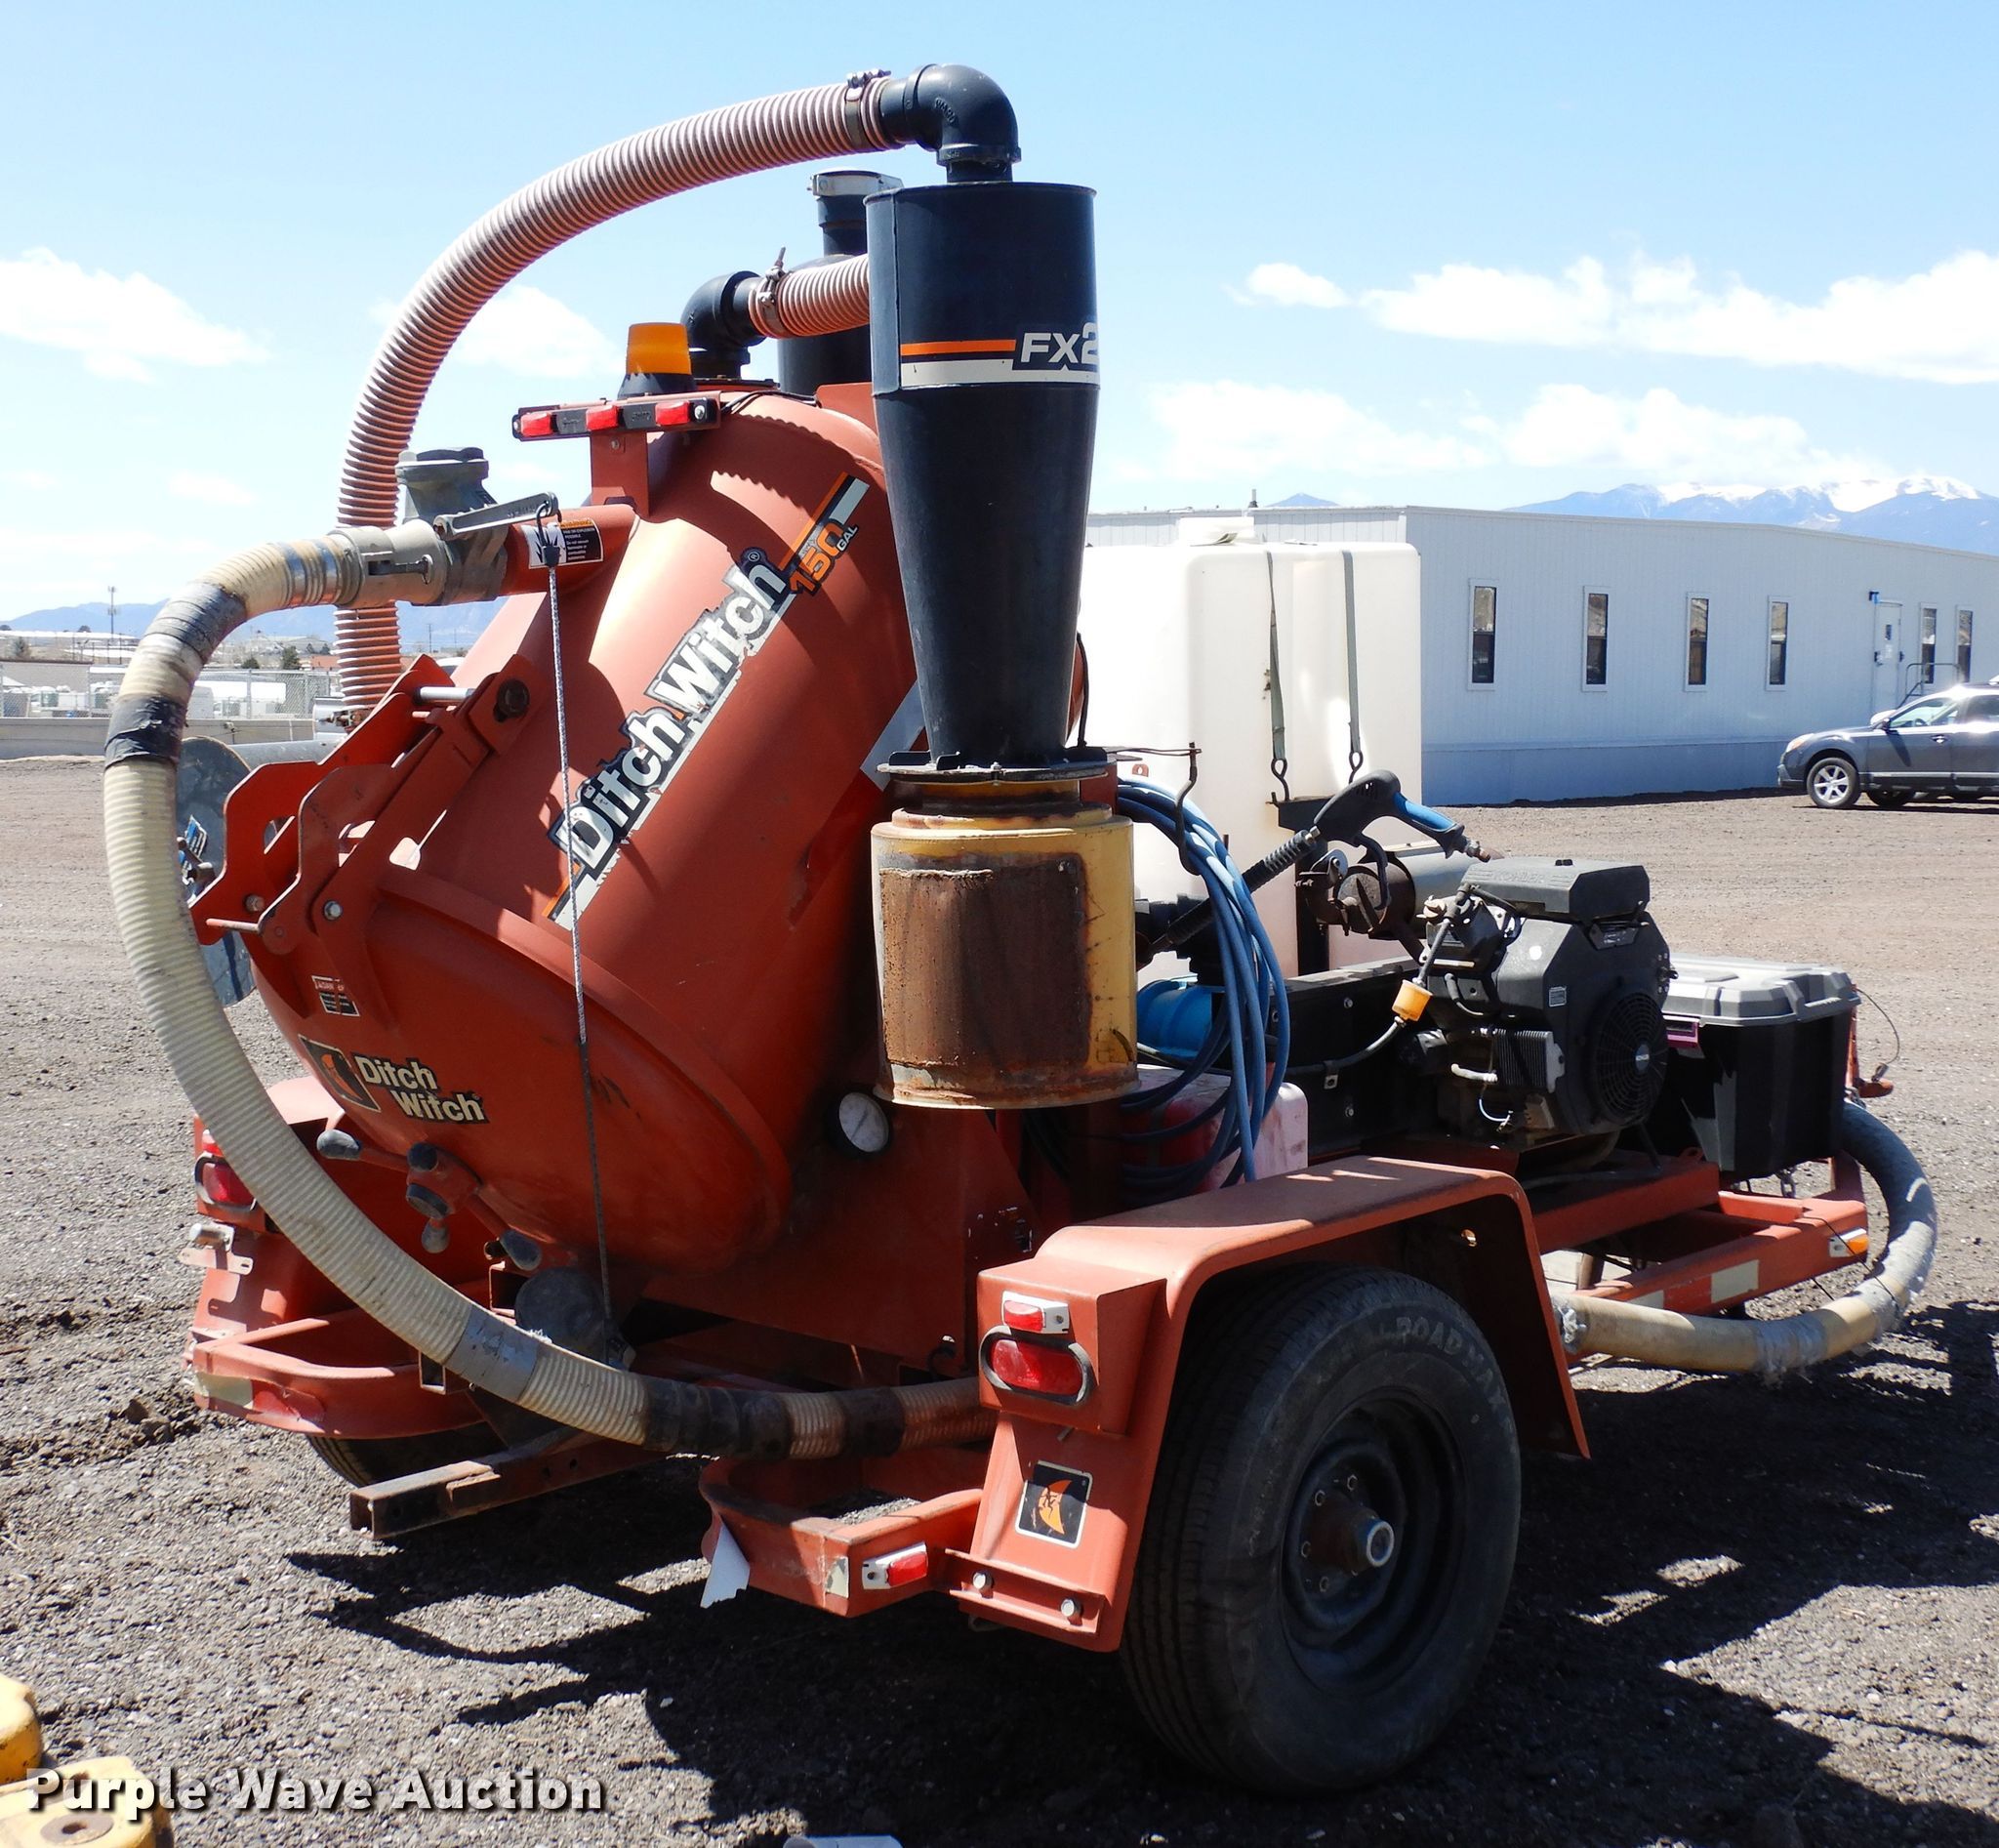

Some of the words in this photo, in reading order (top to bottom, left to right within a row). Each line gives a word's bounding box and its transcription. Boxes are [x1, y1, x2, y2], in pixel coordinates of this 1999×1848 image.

[1021, 321, 1099, 365] FX2
[789, 521, 844, 593] 150
[836, 524, 859, 552] GAL
[554, 712, 686, 870] Ditch
[653, 560, 787, 715] Witch
[354, 1055, 438, 1090] Ditch
[390, 1089, 485, 1122] Witch
